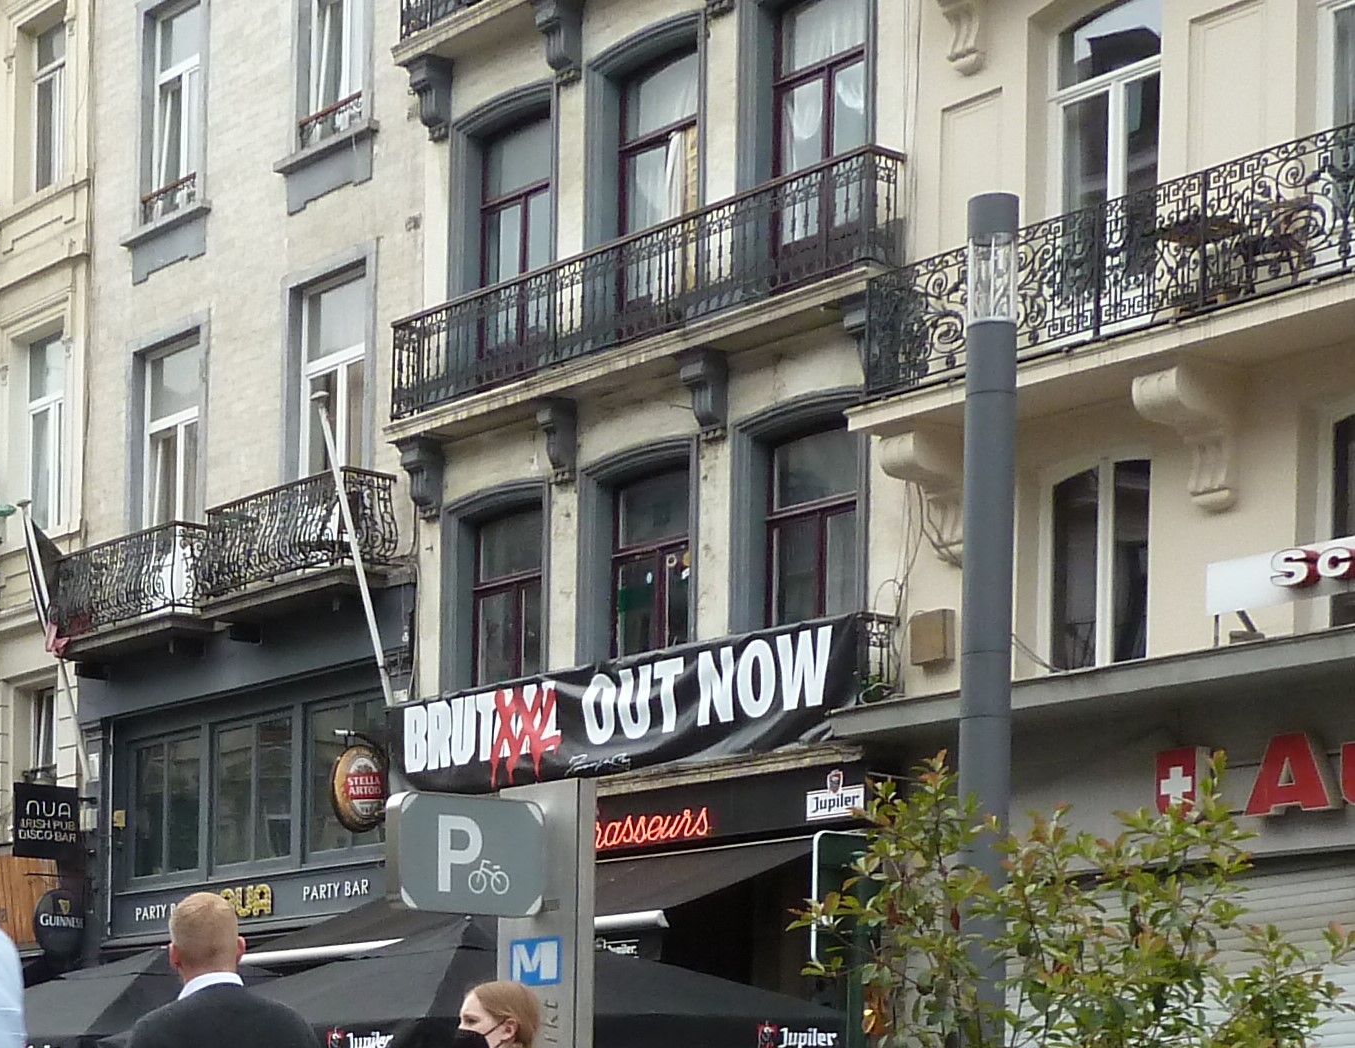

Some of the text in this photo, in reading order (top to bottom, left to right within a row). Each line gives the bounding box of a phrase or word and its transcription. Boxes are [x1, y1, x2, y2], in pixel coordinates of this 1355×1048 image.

[582, 657, 684, 745] OUT
[696, 625, 834, 727] NOW
[347, 776, 381, 786] STELLA
[348, 785, 382, 796] ARTOIS
[811, 793, 861, 814] Jupiler
[20, 818, 77, 832] IRISH PUB
[596, 807, 709, 849] rasseurs
[18, 829, 78, 843] DISCO BAR
[438, 814, 483, 892] P
[302, 879, 370, 902] PARTY BAR
[39, 913, 84, 928] GUINNESS
[135, 904, 167, 922] PARTY
[512, 941, 558, 981] M
